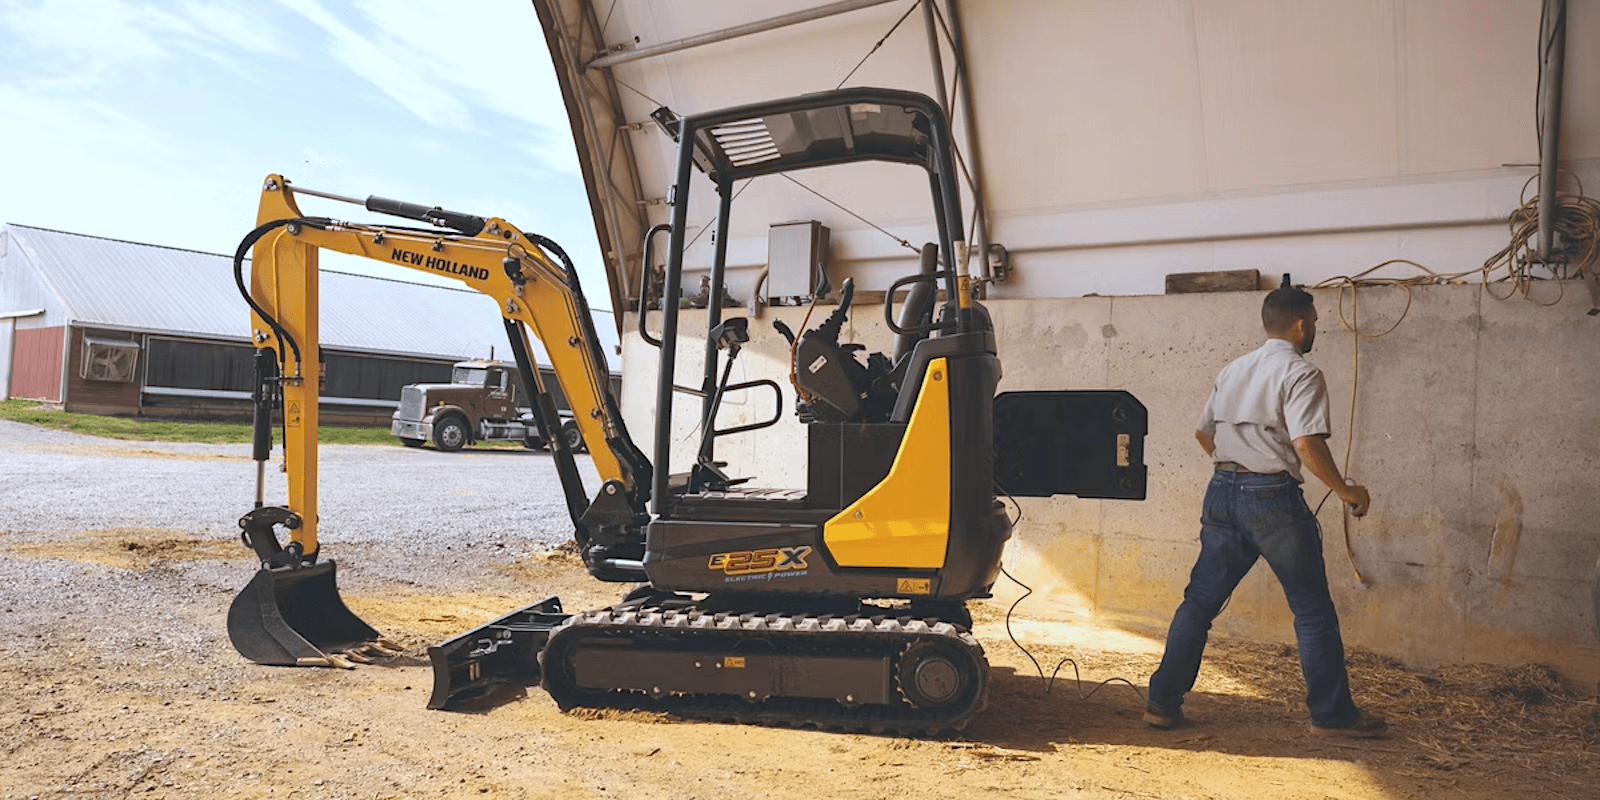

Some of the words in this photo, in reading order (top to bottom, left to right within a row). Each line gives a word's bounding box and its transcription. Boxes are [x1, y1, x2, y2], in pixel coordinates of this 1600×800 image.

[391, 248, 424, 266] NEW
[425, 256, 489, 280] HOLLAND
[725, 573, 767, 582] ELECTRIC
[774, 570, 808, 578] POWER
